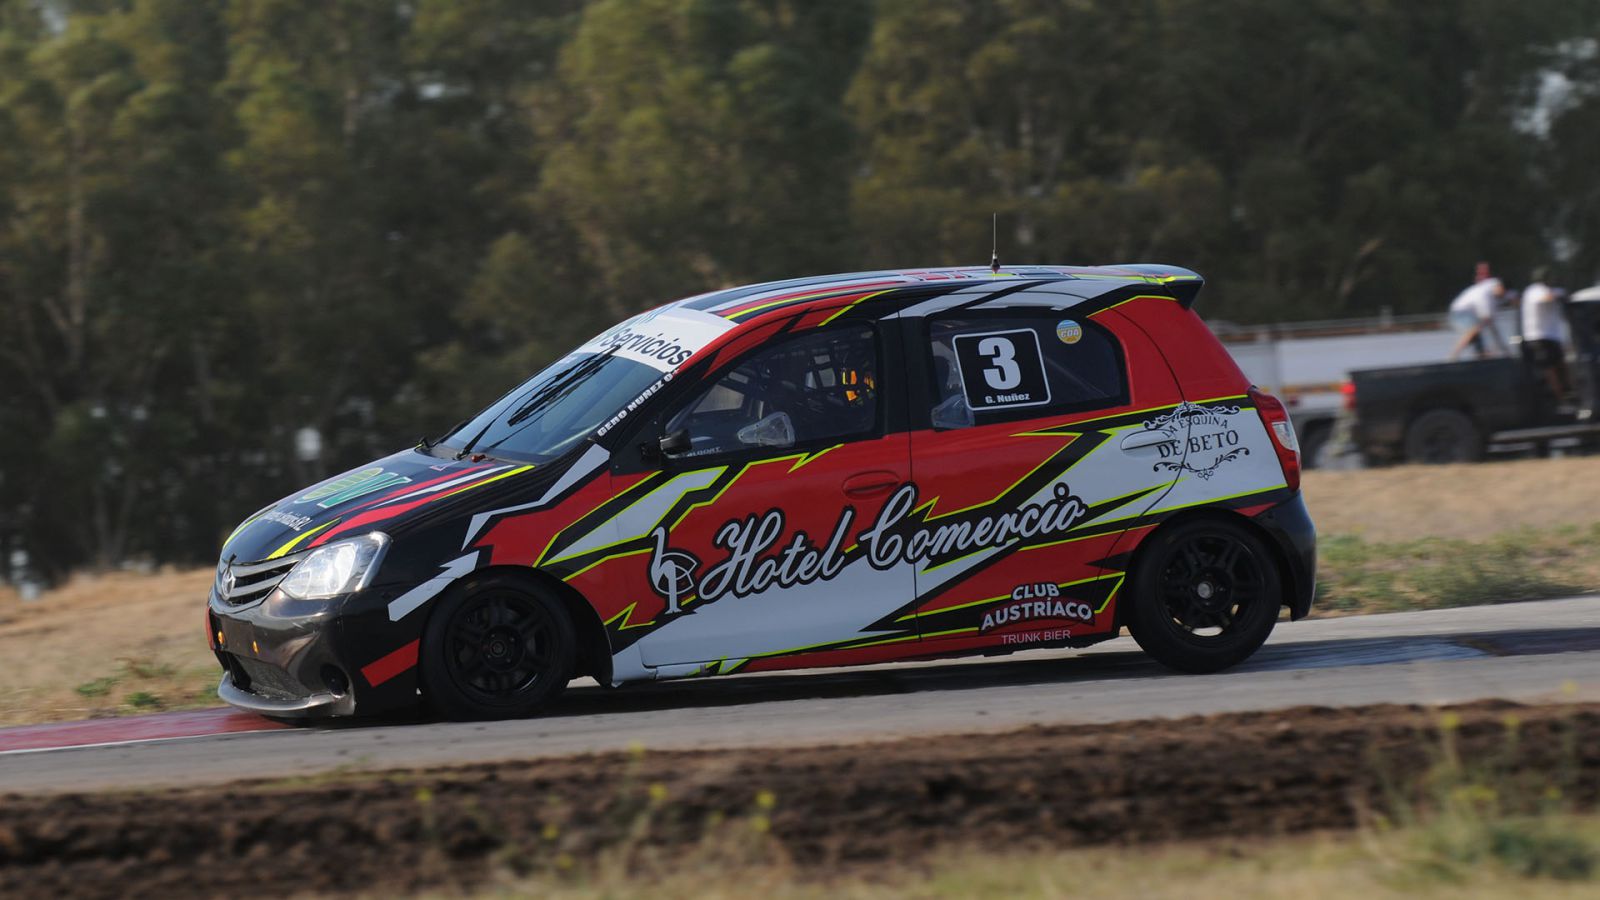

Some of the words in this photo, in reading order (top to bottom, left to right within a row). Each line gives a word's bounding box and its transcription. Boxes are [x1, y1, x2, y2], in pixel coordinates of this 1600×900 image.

[600, 328, 693, 366] Servicios
[978, 337, 1022, 390] 3
[985, 395, 996, 404] G.
[1162, 425, 1178, 438] LA
[1179, 415, 1228, 429] ESQUINA
[1156, 439, 1183, 459] DE
[1187, 429, 1239, 453] BETO
[699, 507, 854, 599] Hotel
[859, 485, 1085, 567] Comercio
[1012, 583, 1060, 601] CLUB
[981, 597, 1092, 631] AUSTRÍACO
[1001, 631, 1041, 645] TRUNK
[1044, 629, 1071, 641] BIER
